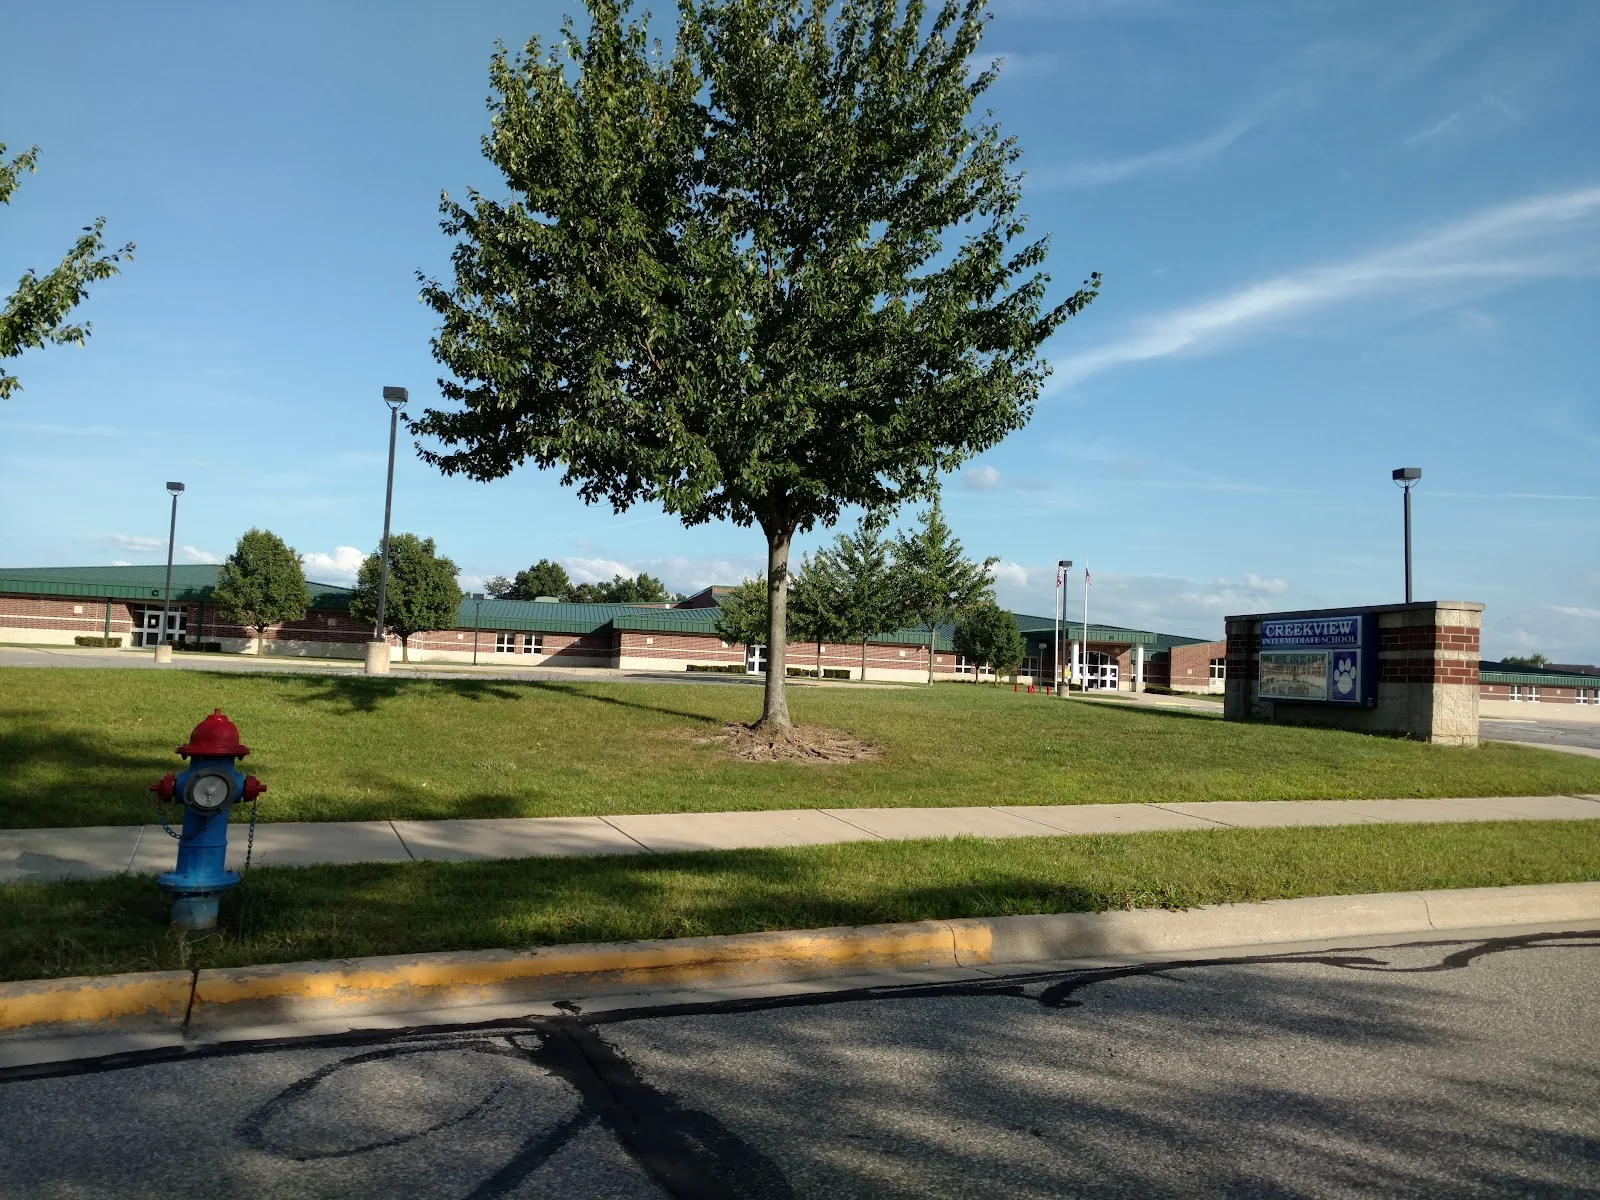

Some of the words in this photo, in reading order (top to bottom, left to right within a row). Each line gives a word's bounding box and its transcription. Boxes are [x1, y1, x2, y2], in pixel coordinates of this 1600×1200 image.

[1265, 621, 1353, 637] CREEKVIEW
[1262, 636, 1320, 645] INTERMEDIATE
[1321, 635, 1357, 644] SCHOOL
